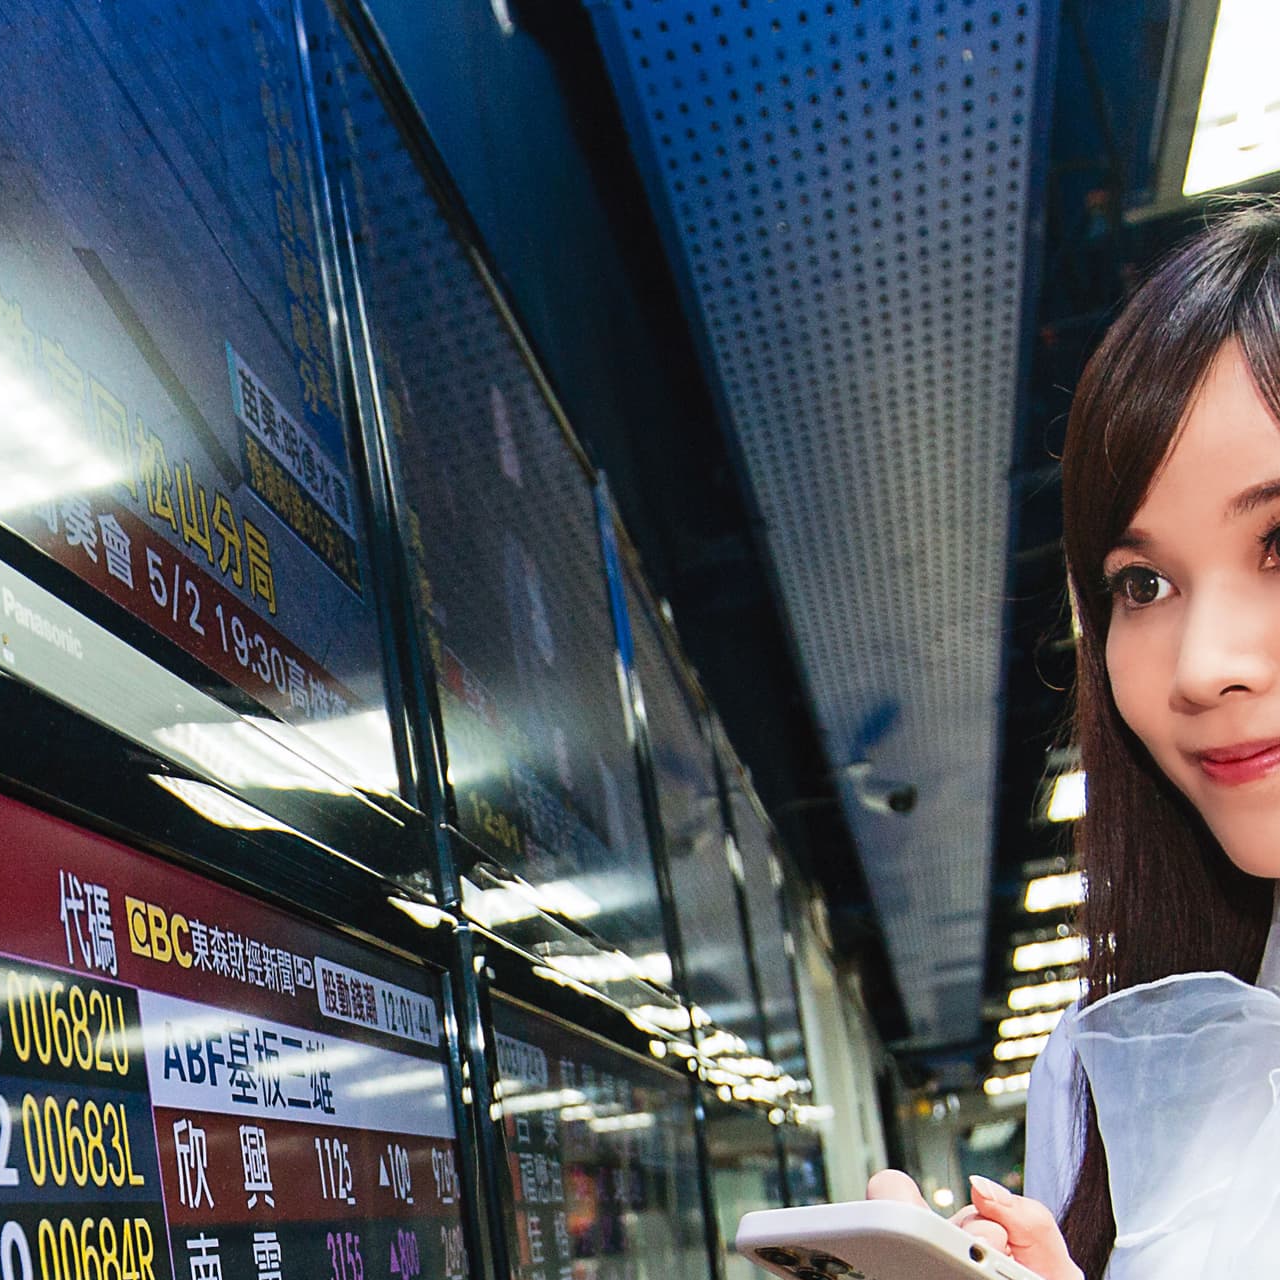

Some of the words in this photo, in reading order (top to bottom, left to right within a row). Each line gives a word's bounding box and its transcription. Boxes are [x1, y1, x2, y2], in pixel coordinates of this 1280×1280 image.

[33, 500, 134, 590] 奏會
[146, 545, 205, 637] 5/2
[2, 586, 84, 660] Panasonic
[59, 869, 118, 977] 代碼
[189, 919, 296, 996] 東森財經新聞
[6, 970, 129, 1077] 00682U
[22, 1093, 145, 1188] 00683L
[173, 1117, 276, 1210] 欣興
[314, 1137, 353, 1199] 1125
[387, 1143, 411, 1200] 100
